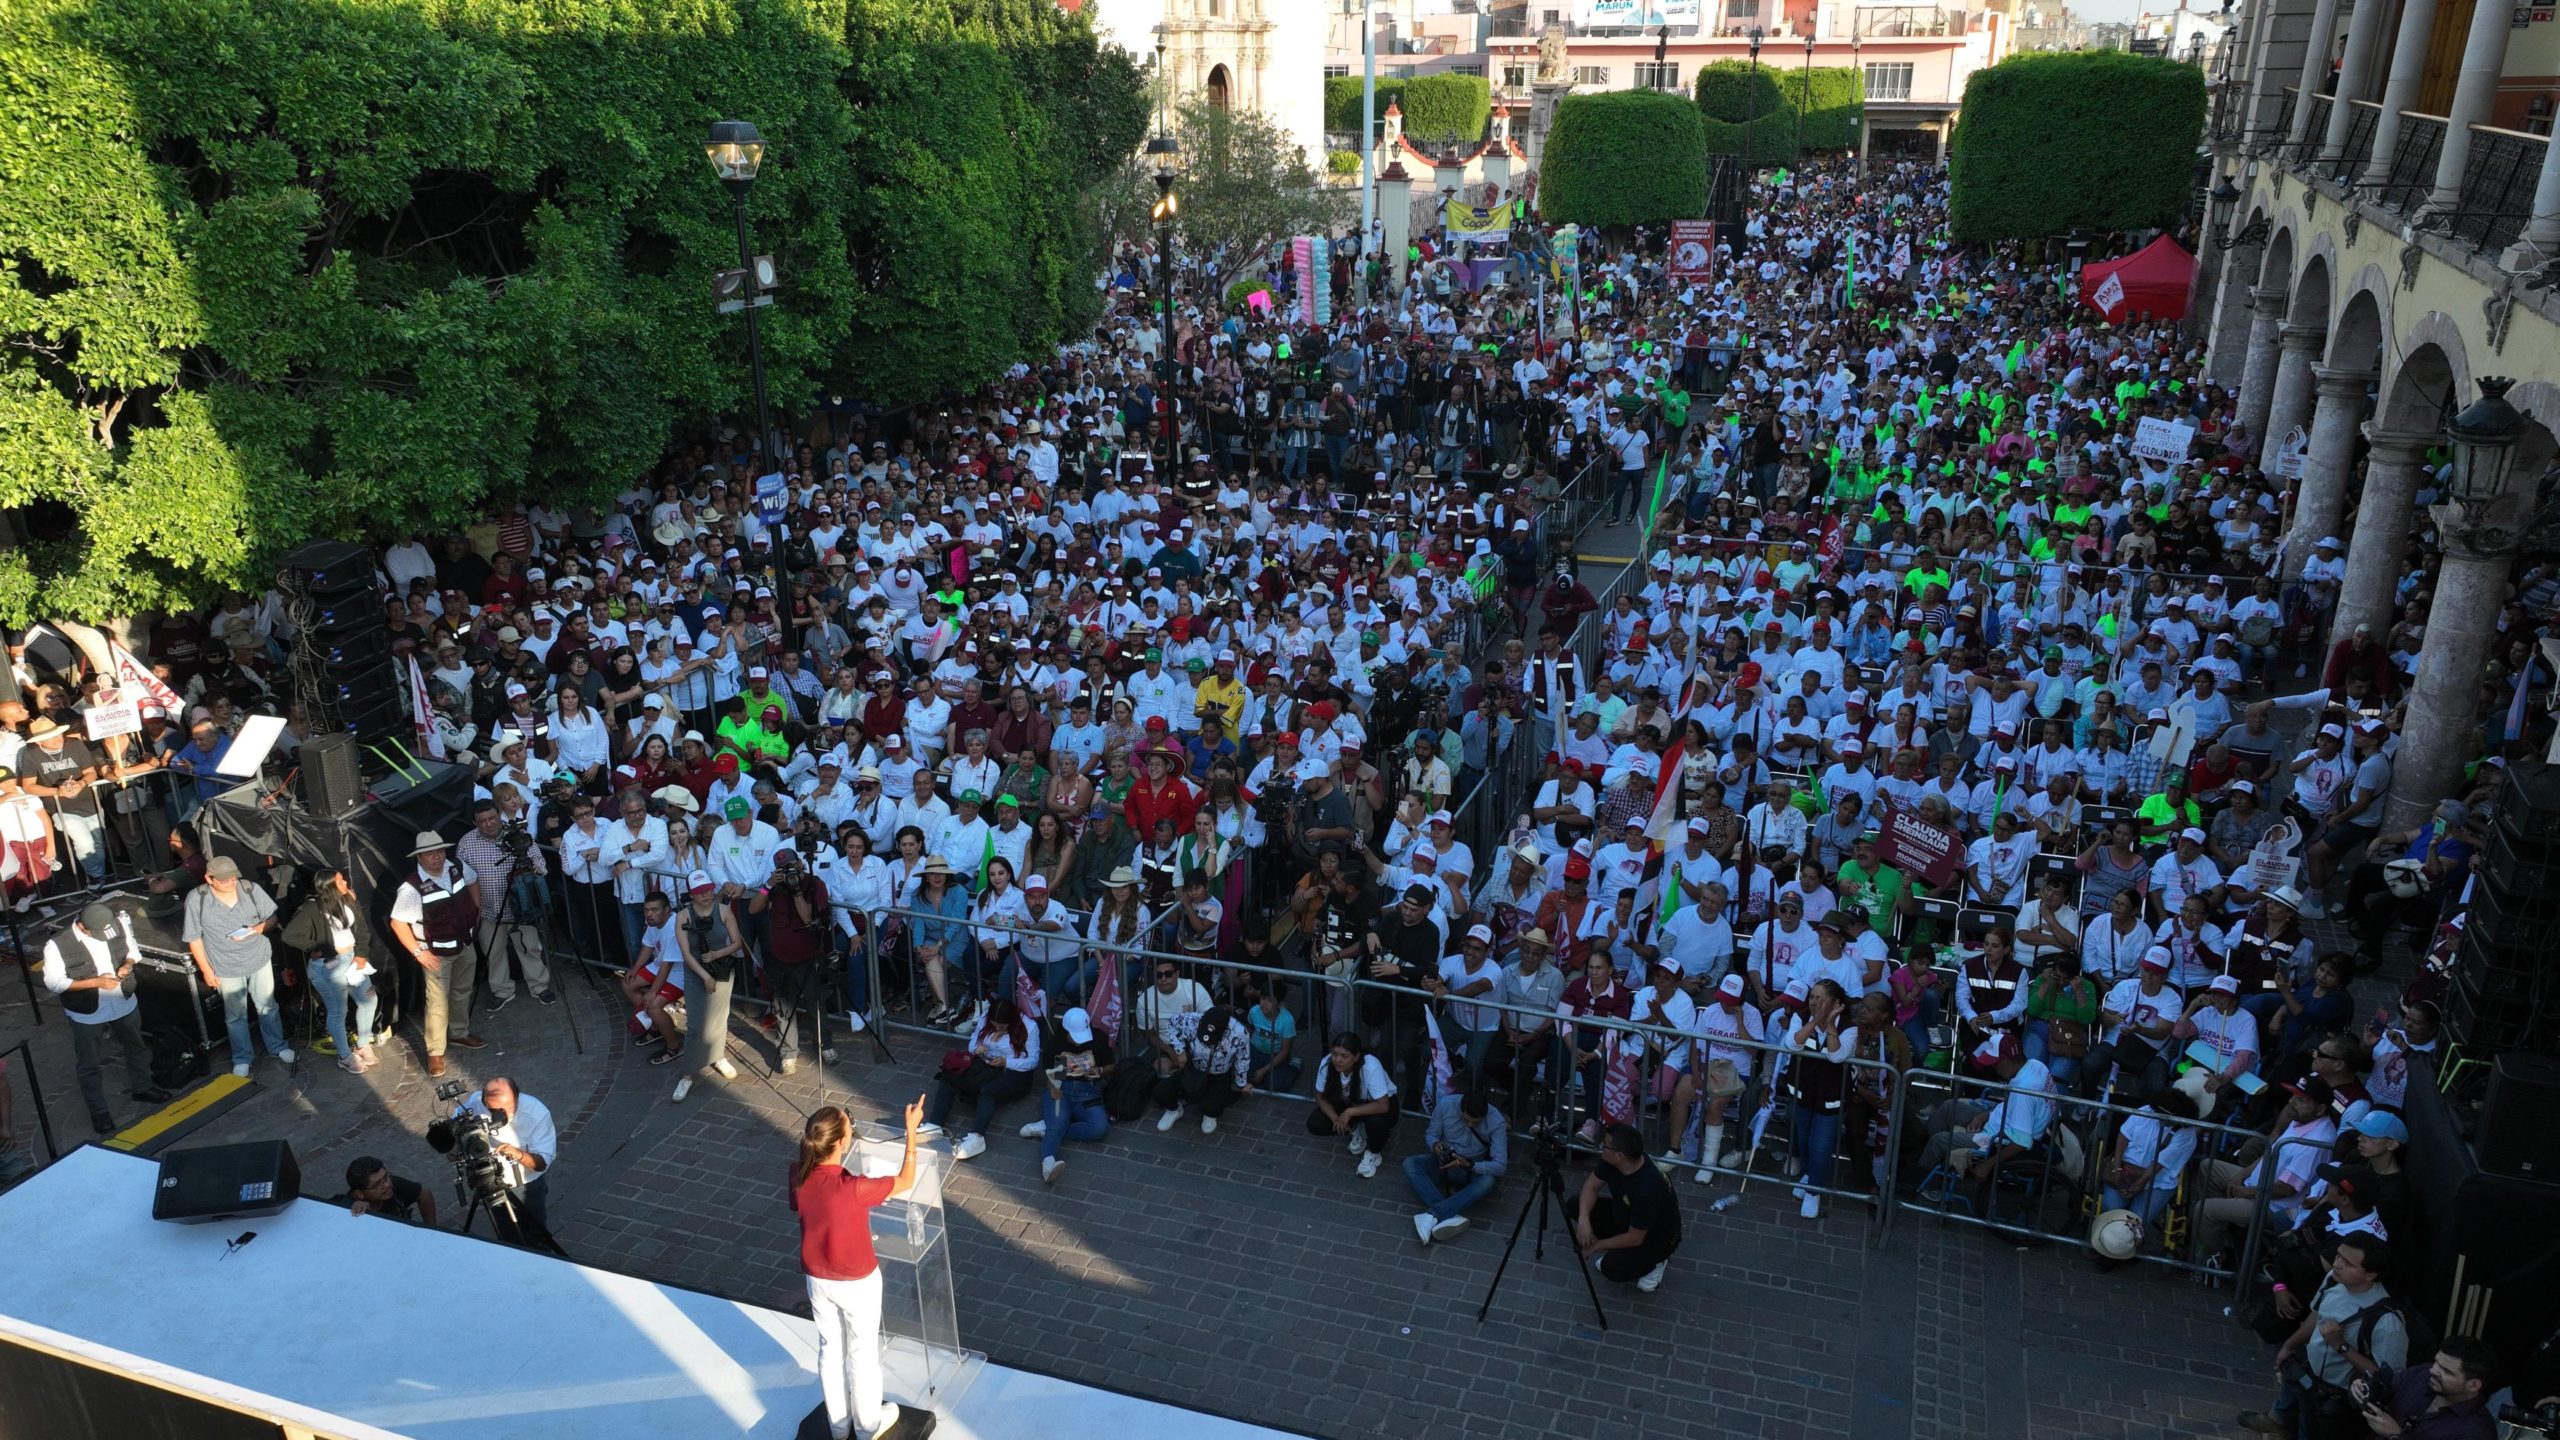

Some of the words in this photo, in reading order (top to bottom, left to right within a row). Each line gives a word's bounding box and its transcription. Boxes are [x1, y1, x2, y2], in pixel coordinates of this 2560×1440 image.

[41, 757, 78, 774] PUMA
[1893, 820, 1949, 853] SHEINBAUM
[1896, 813, 1950, 847] CLAUDIA
[1896, 852, 1927, 871] morena
[2256, 858, 2291, 868] CLAUDIA
[1707, 1027, 1741, 1040] GERARD
